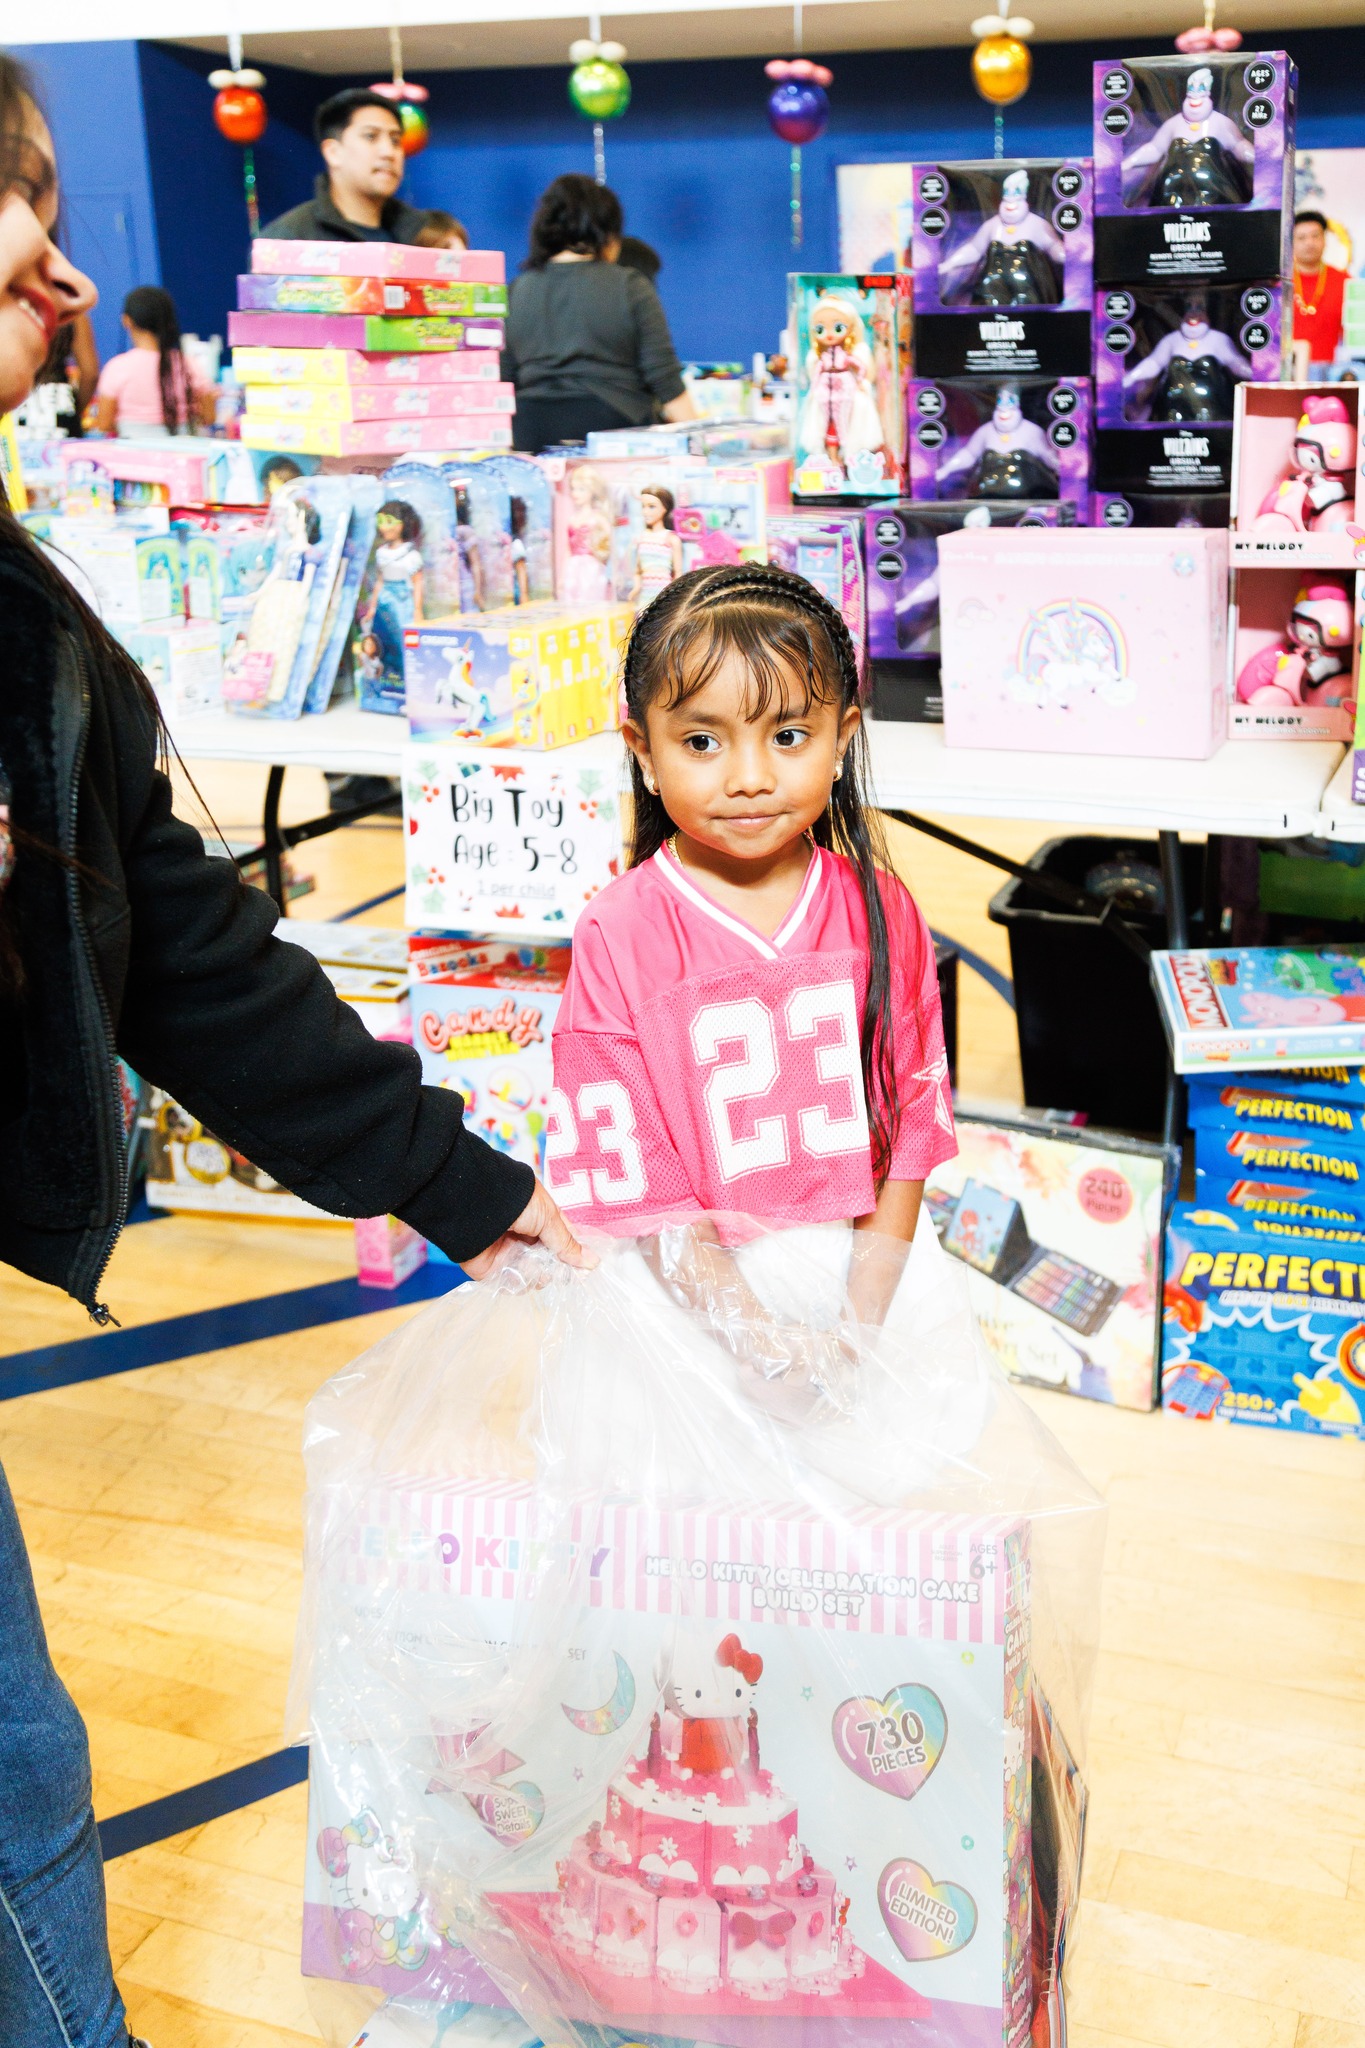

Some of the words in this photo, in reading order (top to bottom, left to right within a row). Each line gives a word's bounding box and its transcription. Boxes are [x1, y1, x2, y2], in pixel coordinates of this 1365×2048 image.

[1251, 69, 1270, 78] AGES
[1170, 243, 1202, 252] URSULA
[450, 784, 493, 823] Big
[503, 788, 564, 827] Toy
[523, 836, 578, 875] 5-8
[490, 884, 514, 898] per
[520, 883, 556, 898] child
[1171, 954, 1227, 1029] MONOPOLY
[419, 996, 544, 1054] Candy
[1187, 1039, 1251, 1052] MONOPOLY
[689, 979, 871, 1184] 23
[1234, 1098, 1354, 1131] PERFECTION
[544, 1080, 648, 1210] 23
[1241, 1148, 1360, 1181] PERFECTION
[1086, 1177, 1124, 1200] 240
[1253, 1219, 1365, 1243] ERFECTION
[1273, 1292, 1311, 1309] CLOCK
[1222, 1392, 1276, 1411] 250+
[475, 1536, 612, 1578] KITY
[969, 1543, 998, 1556] AGES
[711, 1561, 771, 1585] KITTY
[774, 1567, 917, 1598] CELEBRATION
[920, 1579, 980, 1603] CAKE
[969, 1556, 999, 1580] 6+
[752, 1586, 819, 1613] BUILD
[822, 1593, 864, 1617] SET
[856, 1711, 925, 1756] 730
[871, 1746, 927, 1774] PIECES
[494, 1797, 519, 1808] Sup
[495, 1805, 526, 1821] SWEET
[899, 1881, 957, 1926] LIMITED
[889, 1899, 955, 1944] EDITION!
